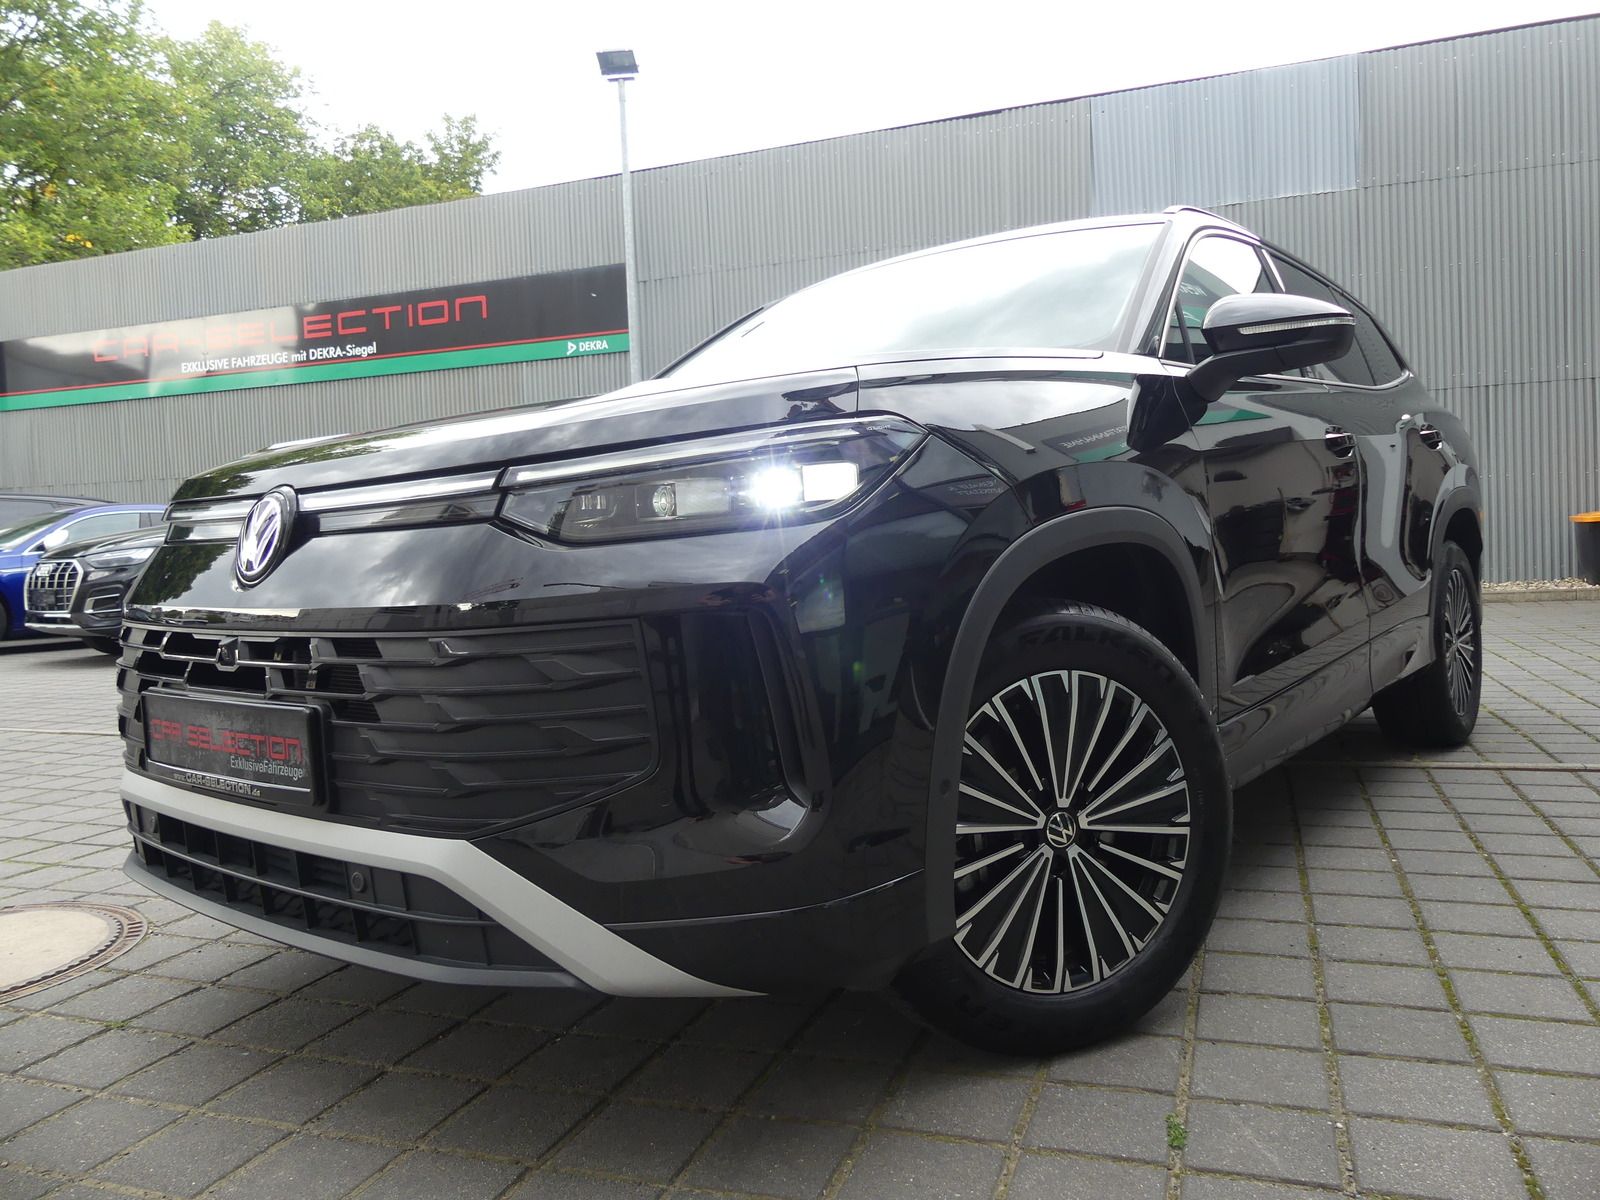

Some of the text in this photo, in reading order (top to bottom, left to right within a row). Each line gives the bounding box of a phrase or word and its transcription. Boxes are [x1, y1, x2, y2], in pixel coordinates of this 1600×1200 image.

[579, 340, 608, 351] DEKRA
[181, 342, 377, 373] EXKLUSIVE FAHRZEUGE mit DEKRA-Siegel
